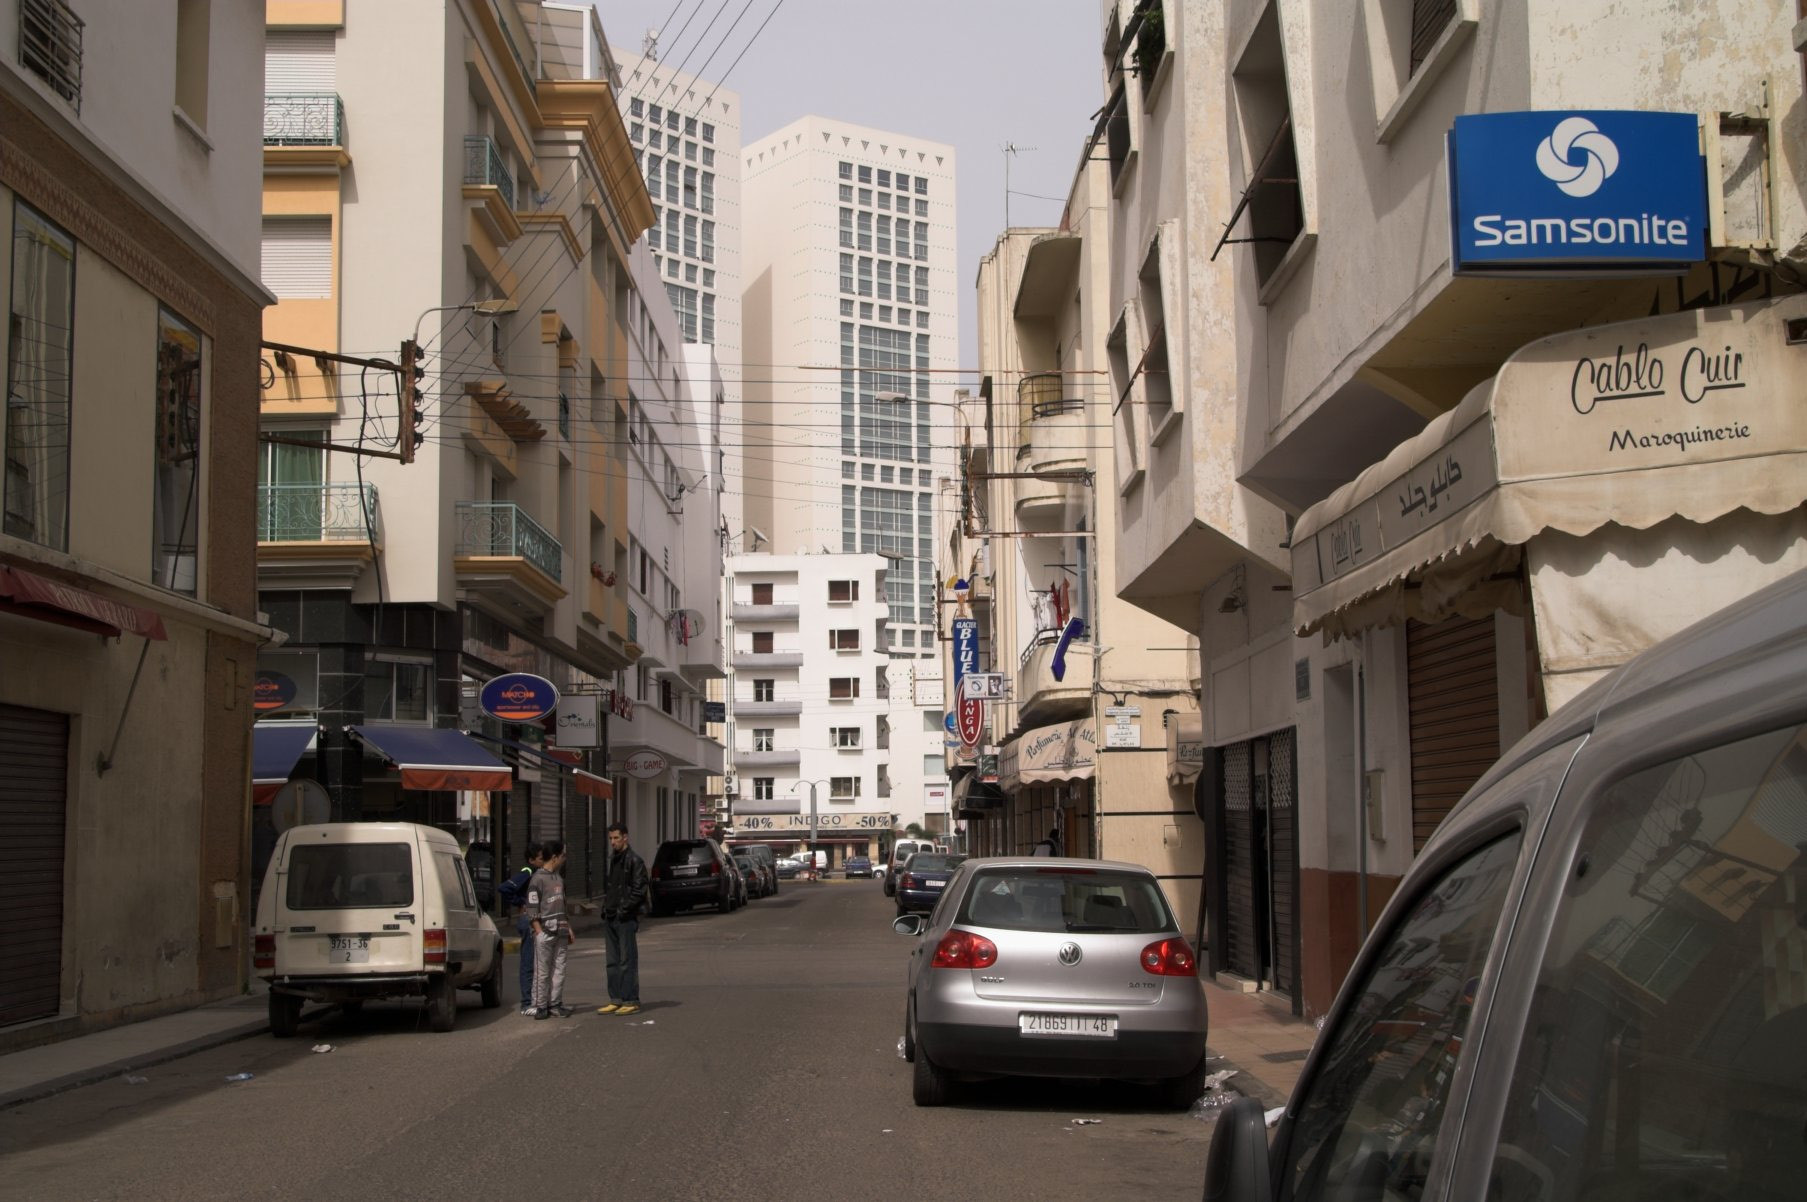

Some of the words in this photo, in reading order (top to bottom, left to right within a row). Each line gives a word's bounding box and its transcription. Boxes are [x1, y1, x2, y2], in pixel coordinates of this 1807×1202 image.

[1473, 213, 1688, 247] Samsonite
[1571, 343, 1665, 415] Cablo
[1680, 345, 1746, 404] Cuir
[1609, 421, 1751, 452] Maroquinerie
[1400, 480, 1428, 518] جلد
[956, 621, 977, 629] GLACIER
[960, 628, 974, 674] BLUE
[964, 699, 975, 735] ANGA
[1026, 729, 1063, 760] Parfumerie
[1080, 728, 1096, 745] Atla
[1179, 743, 1203, 760] Parfu
[626, 761, 638, 770] BIG
[643, 760, 663, 769] GAME
[739, 817, 774, 829] -40%
[855, 815, 890, 828] -50%
[1029, 1014, 1067, 1031] 21869
[1093, 1016, 1108, 1033] 48
